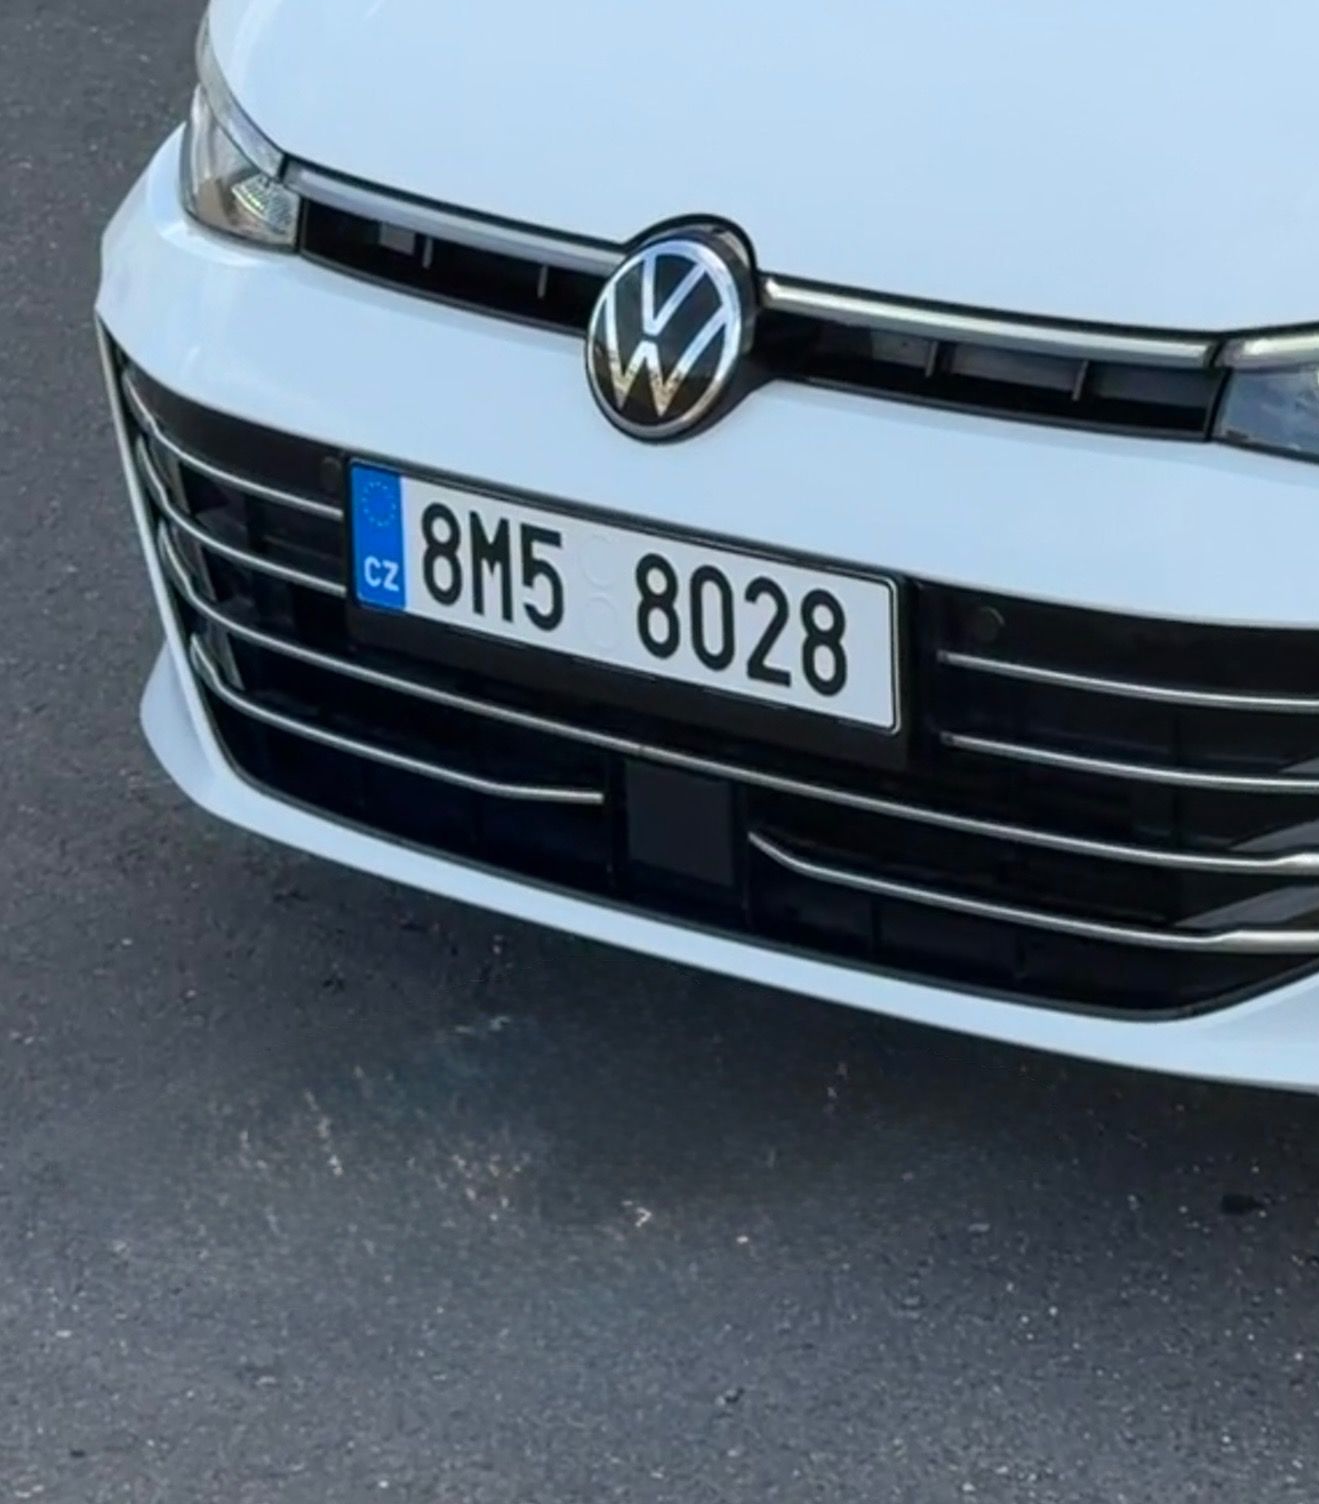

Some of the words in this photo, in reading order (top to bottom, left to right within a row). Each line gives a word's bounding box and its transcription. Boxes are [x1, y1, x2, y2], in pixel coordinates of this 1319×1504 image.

[364, 556, 399, 592] CZ
[421, 502, 564, 632] 8M5
[635, 553, 848, 696] 8028
